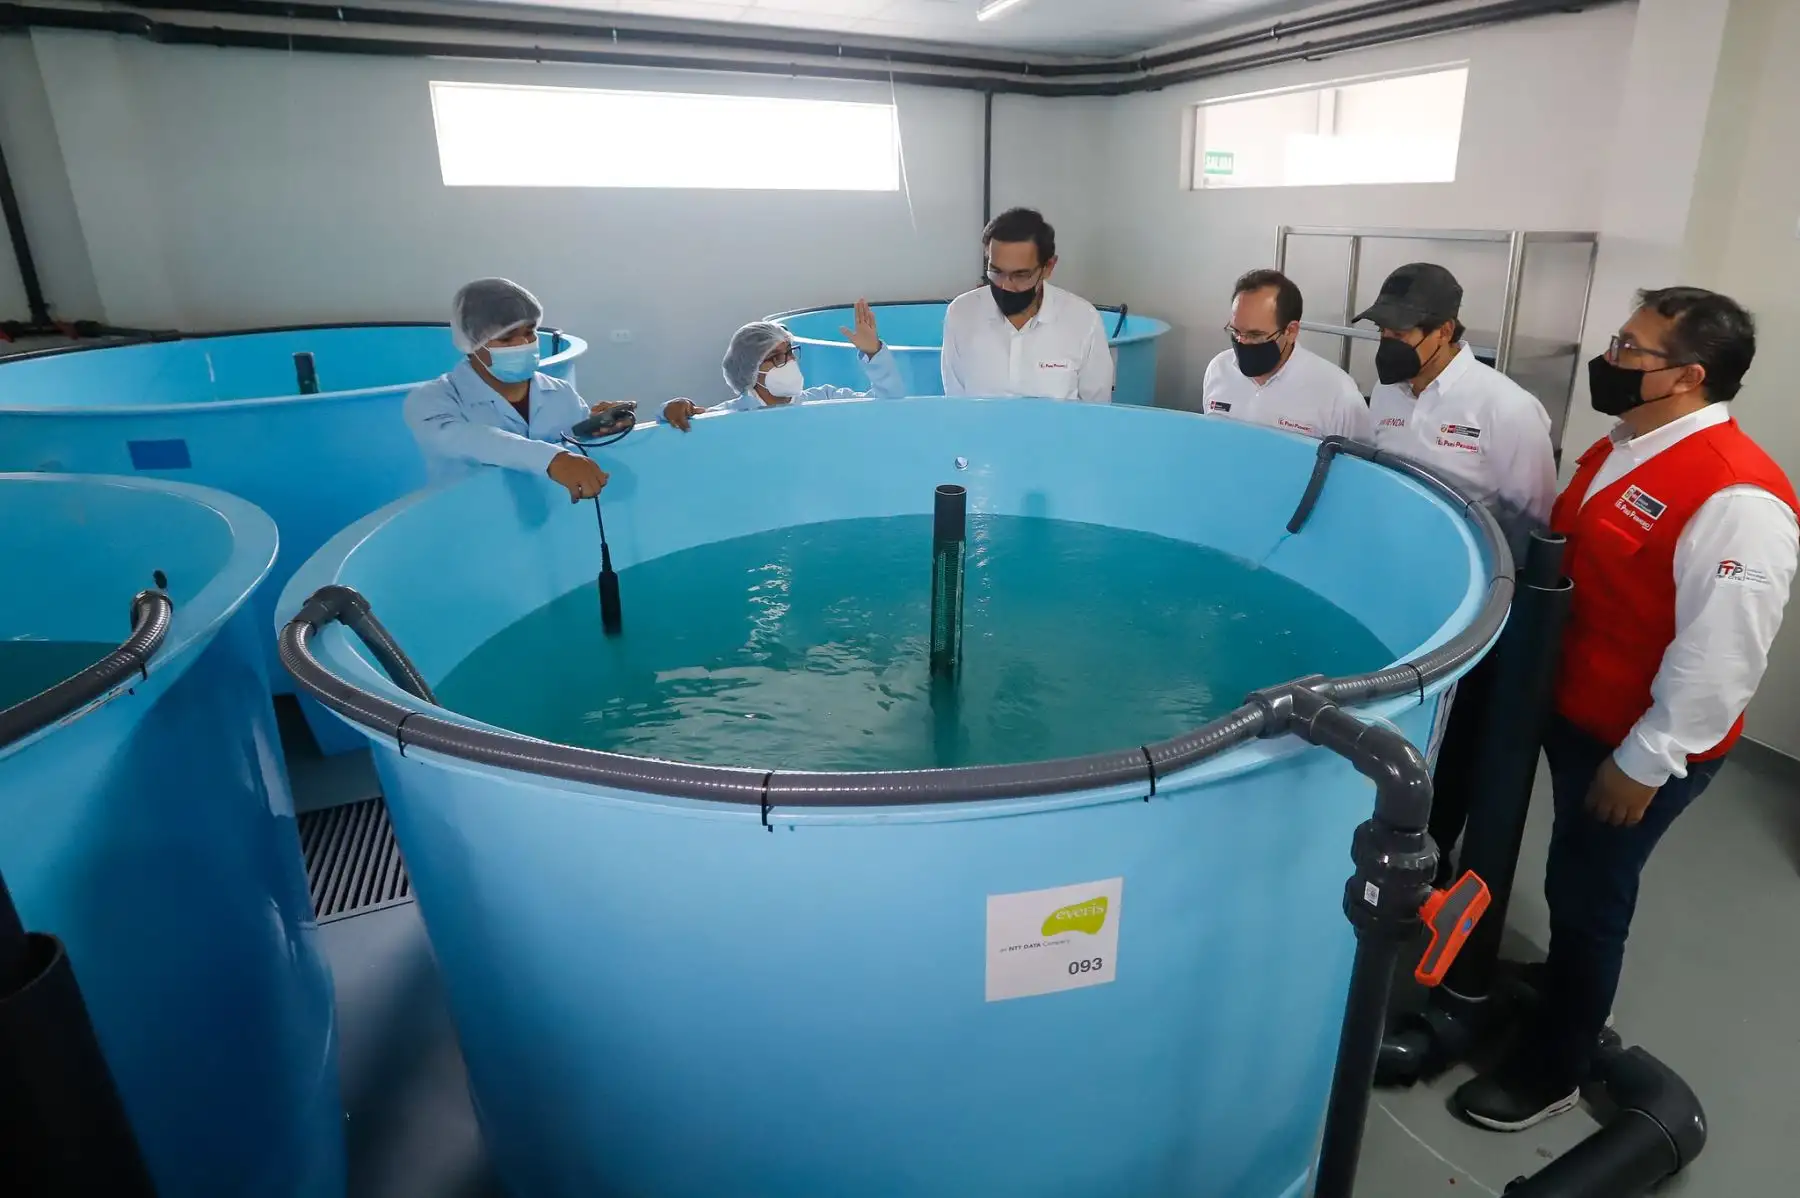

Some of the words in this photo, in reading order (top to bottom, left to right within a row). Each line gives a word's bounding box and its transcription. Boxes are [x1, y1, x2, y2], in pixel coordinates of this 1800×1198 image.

[1717, 564, 1743, 576] ITP
[1056, 903, 1104, 920] everis
[1023, 942, 1041, 950] DATA
[1068, 957, 1103, 975] 093
